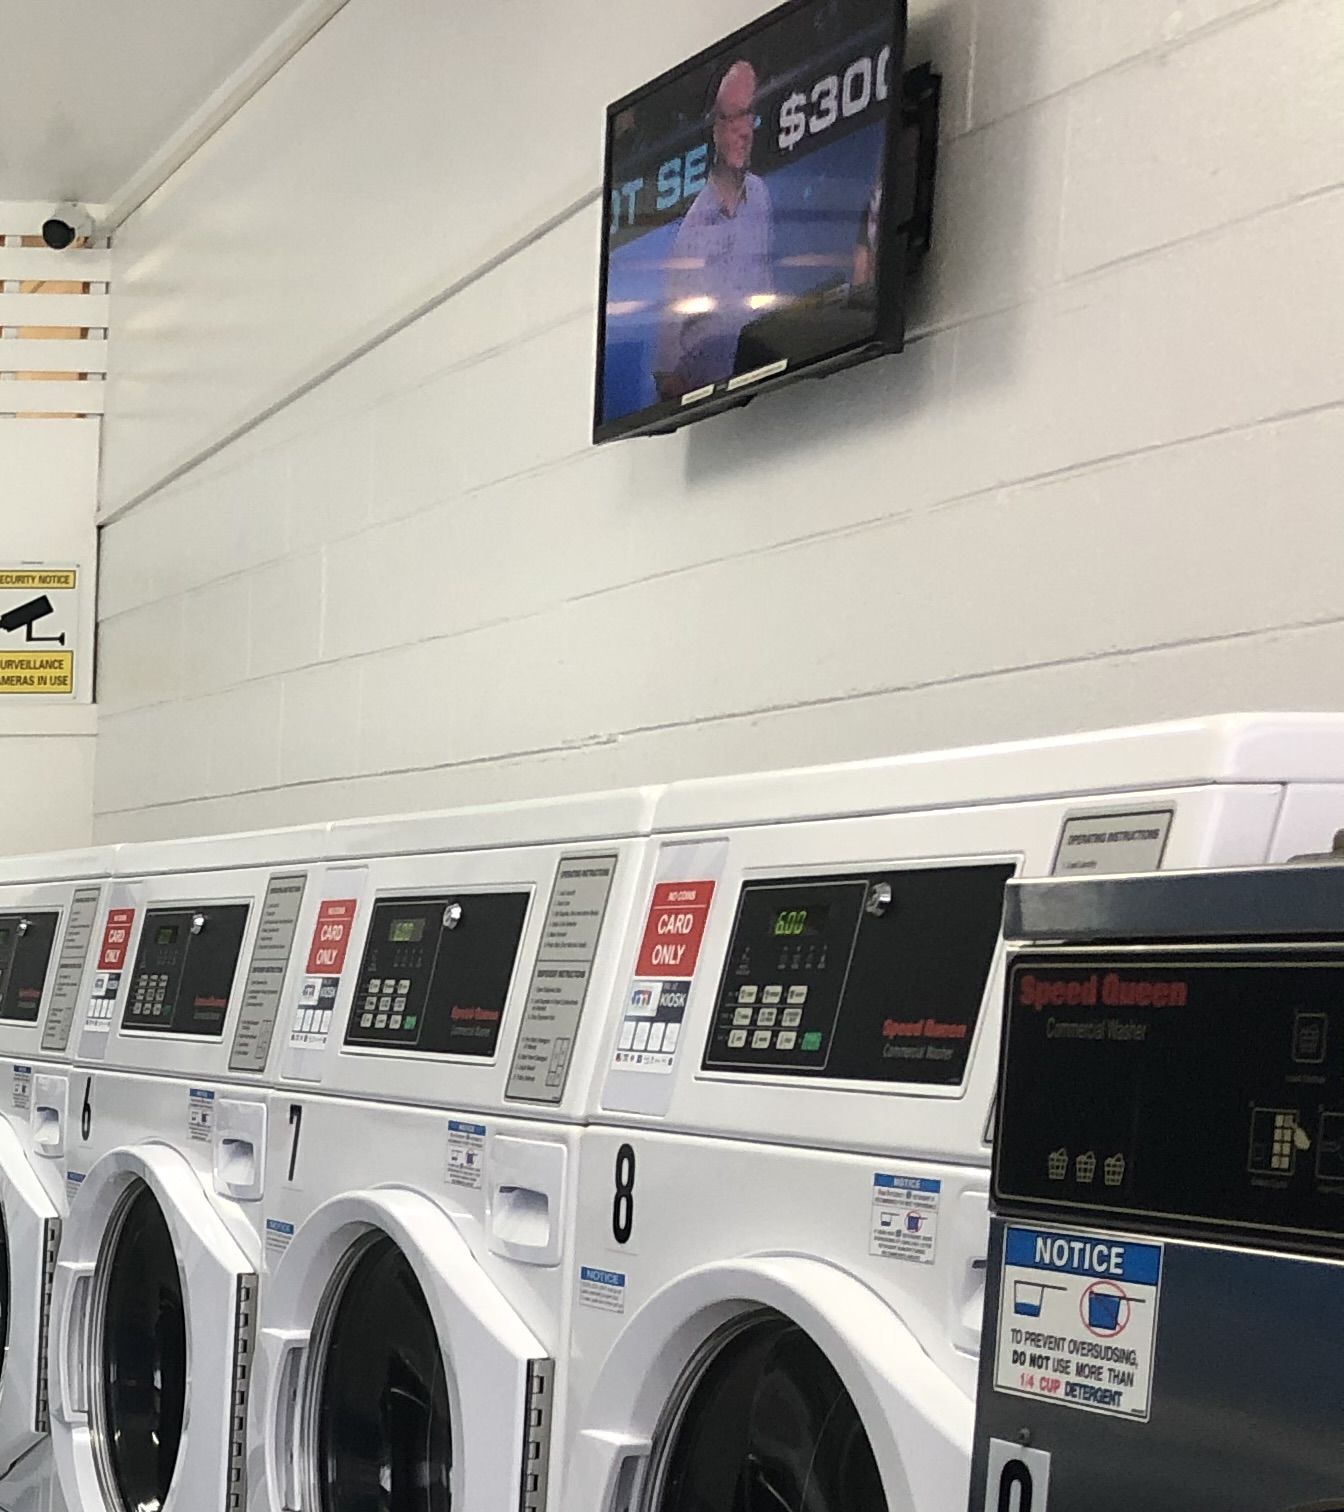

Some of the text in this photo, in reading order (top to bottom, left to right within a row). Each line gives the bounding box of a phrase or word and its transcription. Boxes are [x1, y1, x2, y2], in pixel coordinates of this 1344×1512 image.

[38, 574, 71, 585] NOTICE
[37, 675, 47, 686] IN
[49, 675, 69, 687] USE
[320, 924, 344, 942] CARD
[657, 913, 694, 935] CARD
[315, 949, 339, 965] ONLY
[652, 944, 687, 965] ONLY
[660, 992, 687, 1008] KIOSK
[1020, 972, 1188, 1010] Speed Queen
[81, 1076, 92, 1141] 6
[287, 1103, 303, 1182] 7
[612, 1142, 636, 1245] 8
[1034, 1236, 1126, 1275] NOTICE
[586, 1269, 618, 1285] NOTICE
[1010, 1327, 1138, 1369] TO PREVENT OVERSUDSING,
[1012, 1349, 1135, 1388] DO NOT USE MORE THAN
[1039, 1376, 1061, 1394] CUP
[1064, 1380, 1123, 1407] DETERGENT
